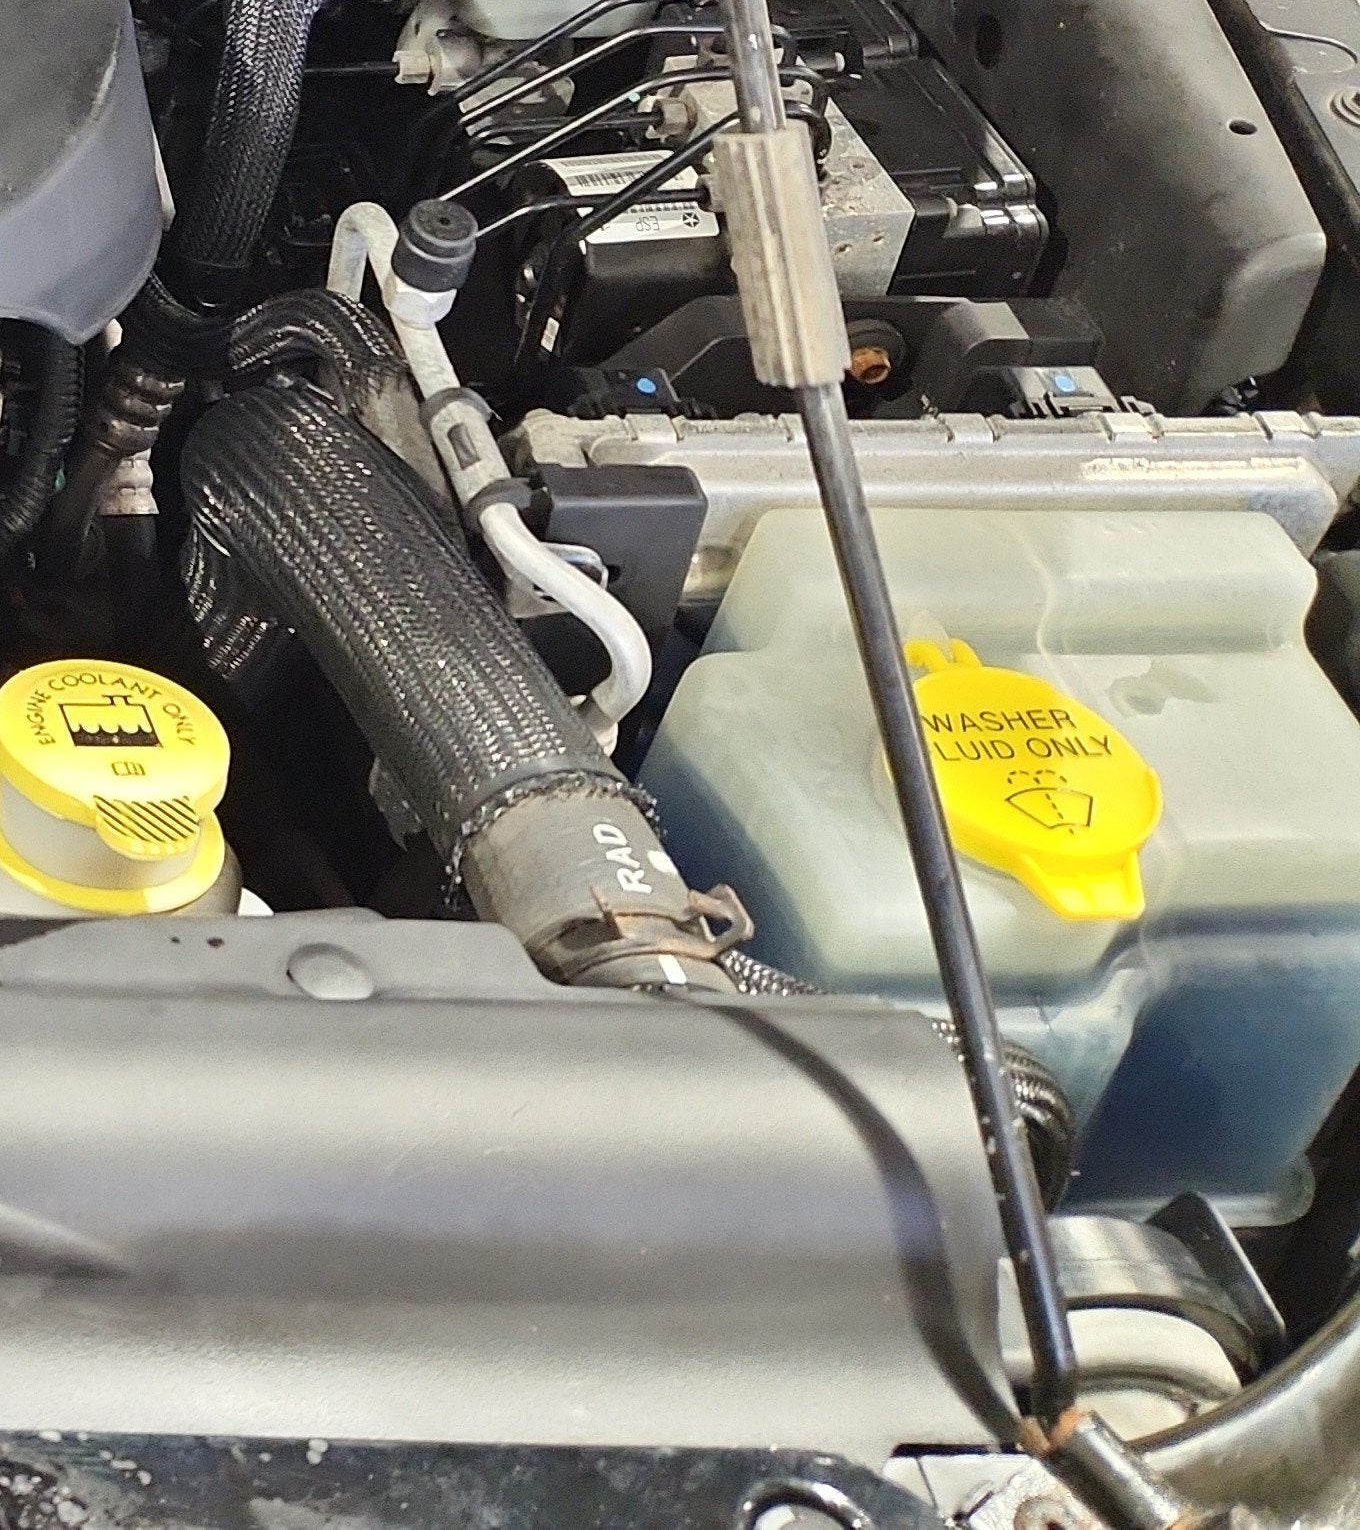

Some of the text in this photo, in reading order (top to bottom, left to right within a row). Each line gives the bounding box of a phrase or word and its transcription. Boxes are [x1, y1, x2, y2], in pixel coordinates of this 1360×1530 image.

[635, 215, 660, 232] ESP
[25, 671, 197, 748] ENGINE COOLANT ONLY
[921, 708, 1078, 733] WASHER
[931, 734, 1114, 763] LUID ONLY
[592, 823, 653, 894] RAD
